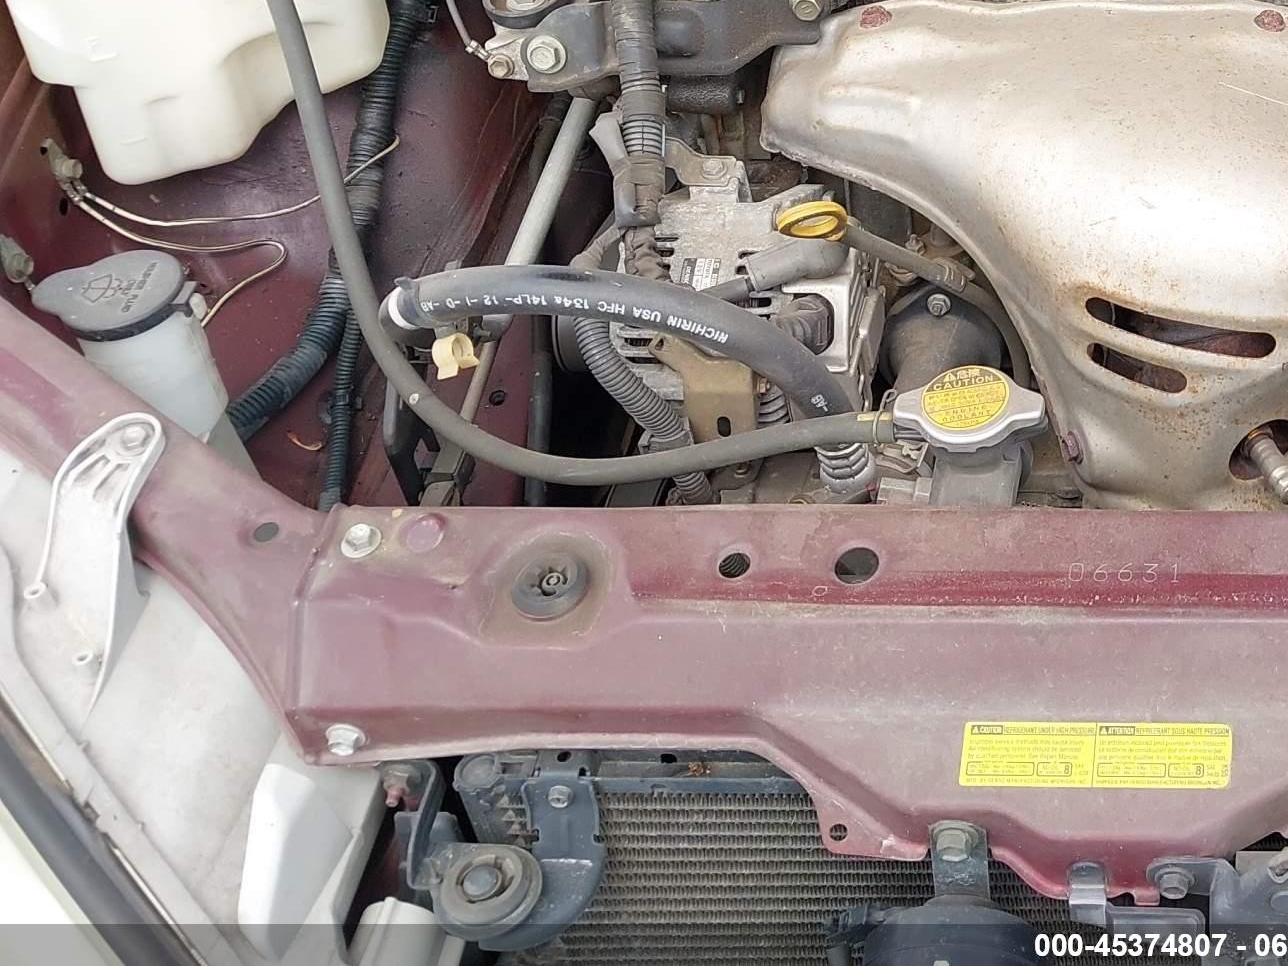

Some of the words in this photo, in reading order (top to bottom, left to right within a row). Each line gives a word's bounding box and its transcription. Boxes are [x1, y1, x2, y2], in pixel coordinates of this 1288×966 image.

[598, 301, 625, 315] HFC
[632, 306, 661, 323] USA
[666, 314, 729, 344] NICHIRIN
[933, 375, 994, 391] CAUTION
[1068, 562, 1180, 584] 06631
